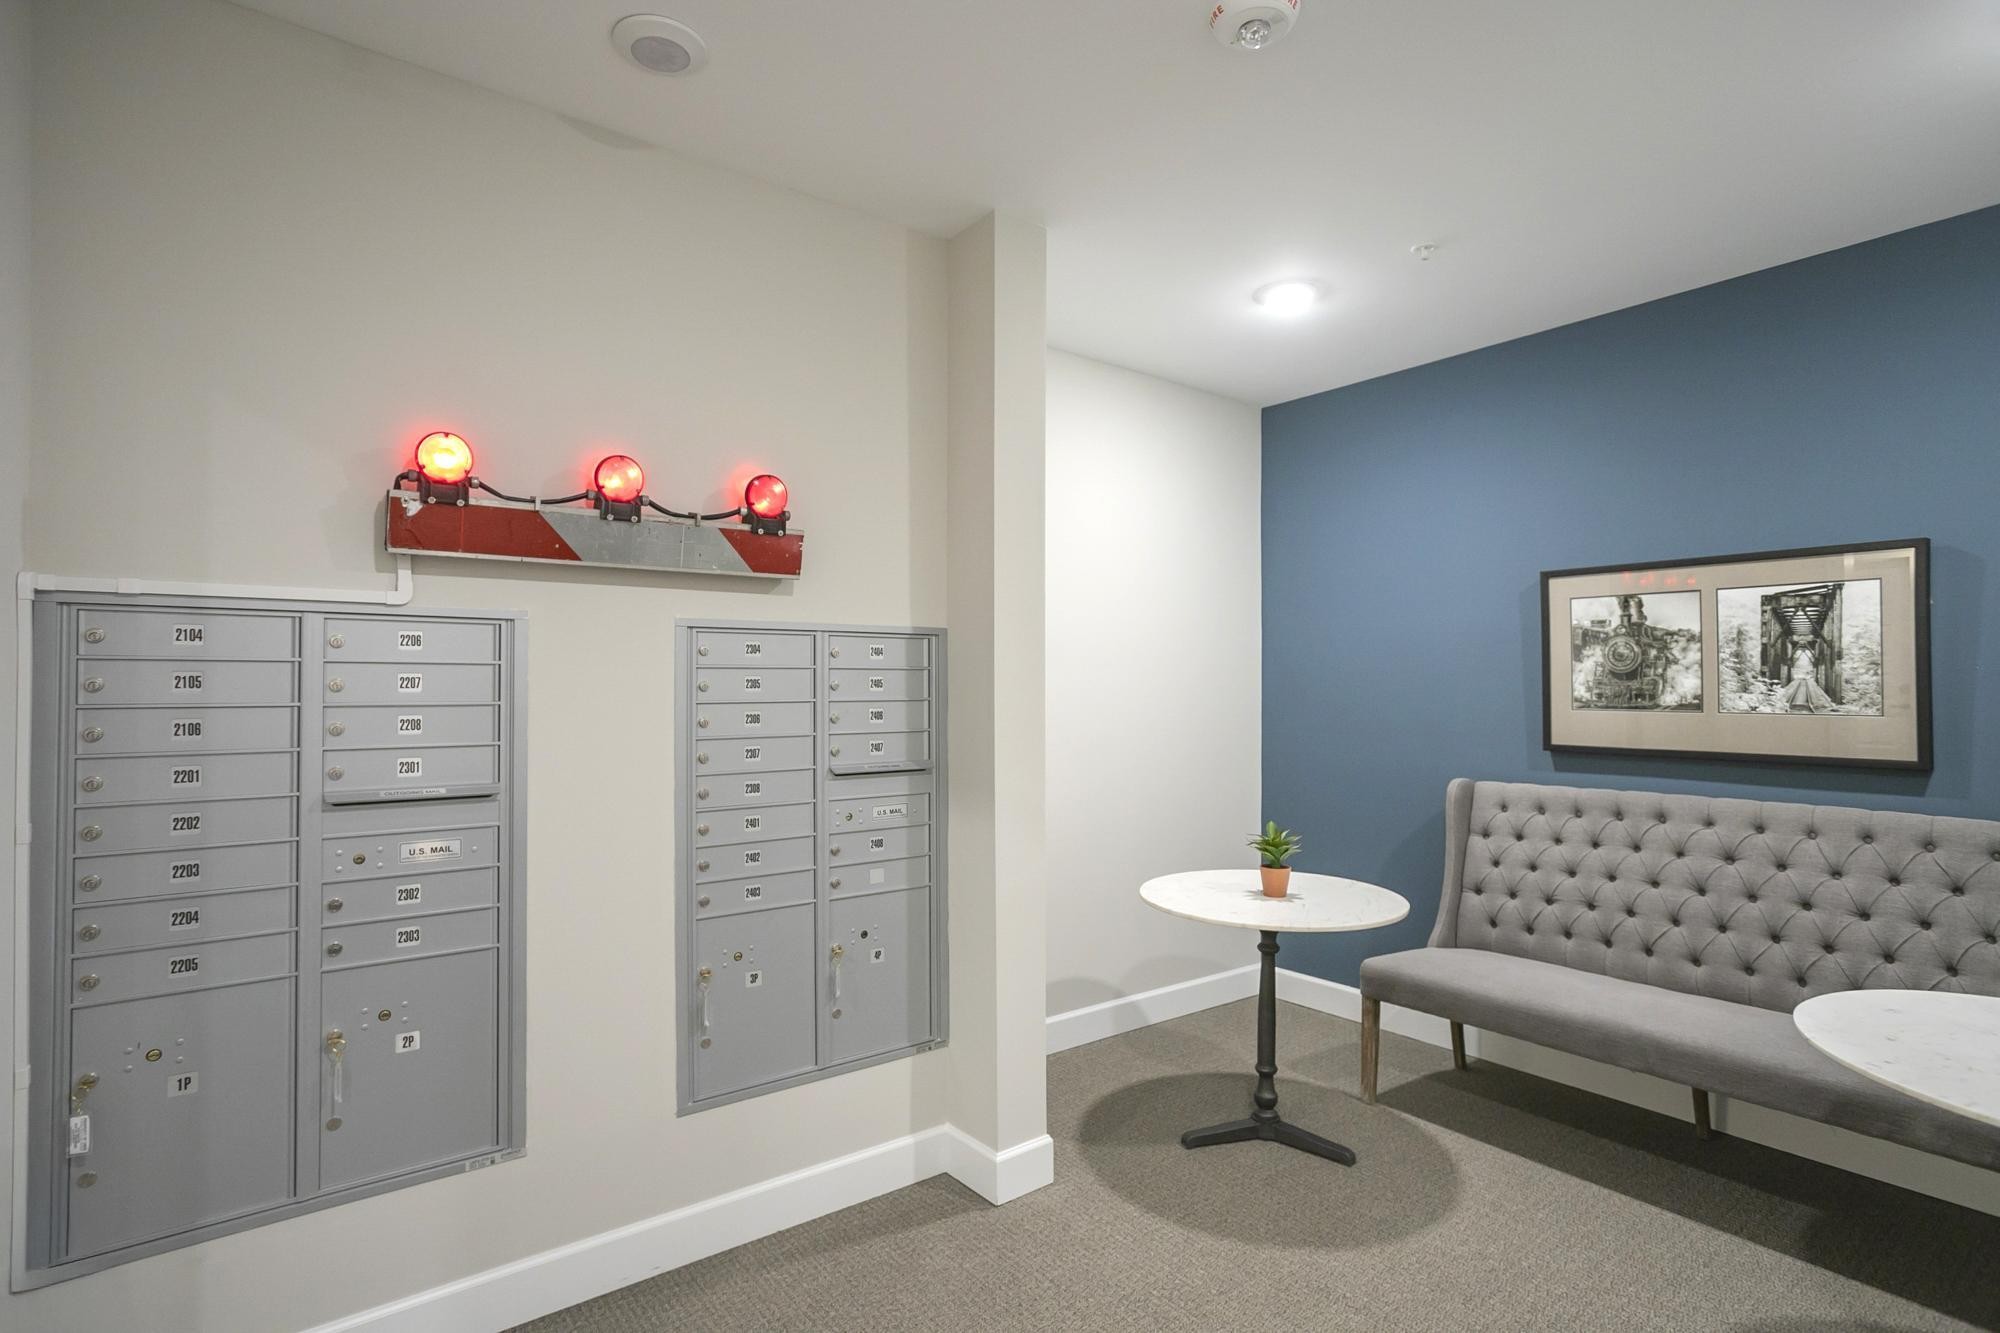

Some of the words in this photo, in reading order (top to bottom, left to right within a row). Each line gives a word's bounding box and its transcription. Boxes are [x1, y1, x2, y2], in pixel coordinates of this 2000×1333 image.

[176, 628, 202, 641] 2104
[400, 635, 421, 646] 2206
[746, 644, 760, 655] 2304
[175, 676, 201, 688] 2105
[400, 677, 420, 688] 2207
[746, 679, 760, 690] 2305
[400, 719, 421, 731] 2208
[746, 714, 760, 725] 2306
[174, 723, 201, 736] 2106
[745, 748, 760, 760] 2307
[871, 743, 883, 753] 2407
[399, 762, 419, 773] 2301
[174, 770, 199, 783] 2201
[745, 783, 760, 794] 2308
[173, 816, 200, 830] 2202
[745, 818, 759, 829] 2401
[408, 848, 427, 856] U.S.
[430, 846, 453, 854] MAIL
[173, 864, 199, 878] 2203
[398, 888, 419, 901] 2302
[172, 911, 199, 926] 2204
[398, 929, 419, 943] 2303
[171, 958, 198, 974] 2205
[403, 1036, 414, 1048] 2P
[177, 1077, 191, 1091] 1P
